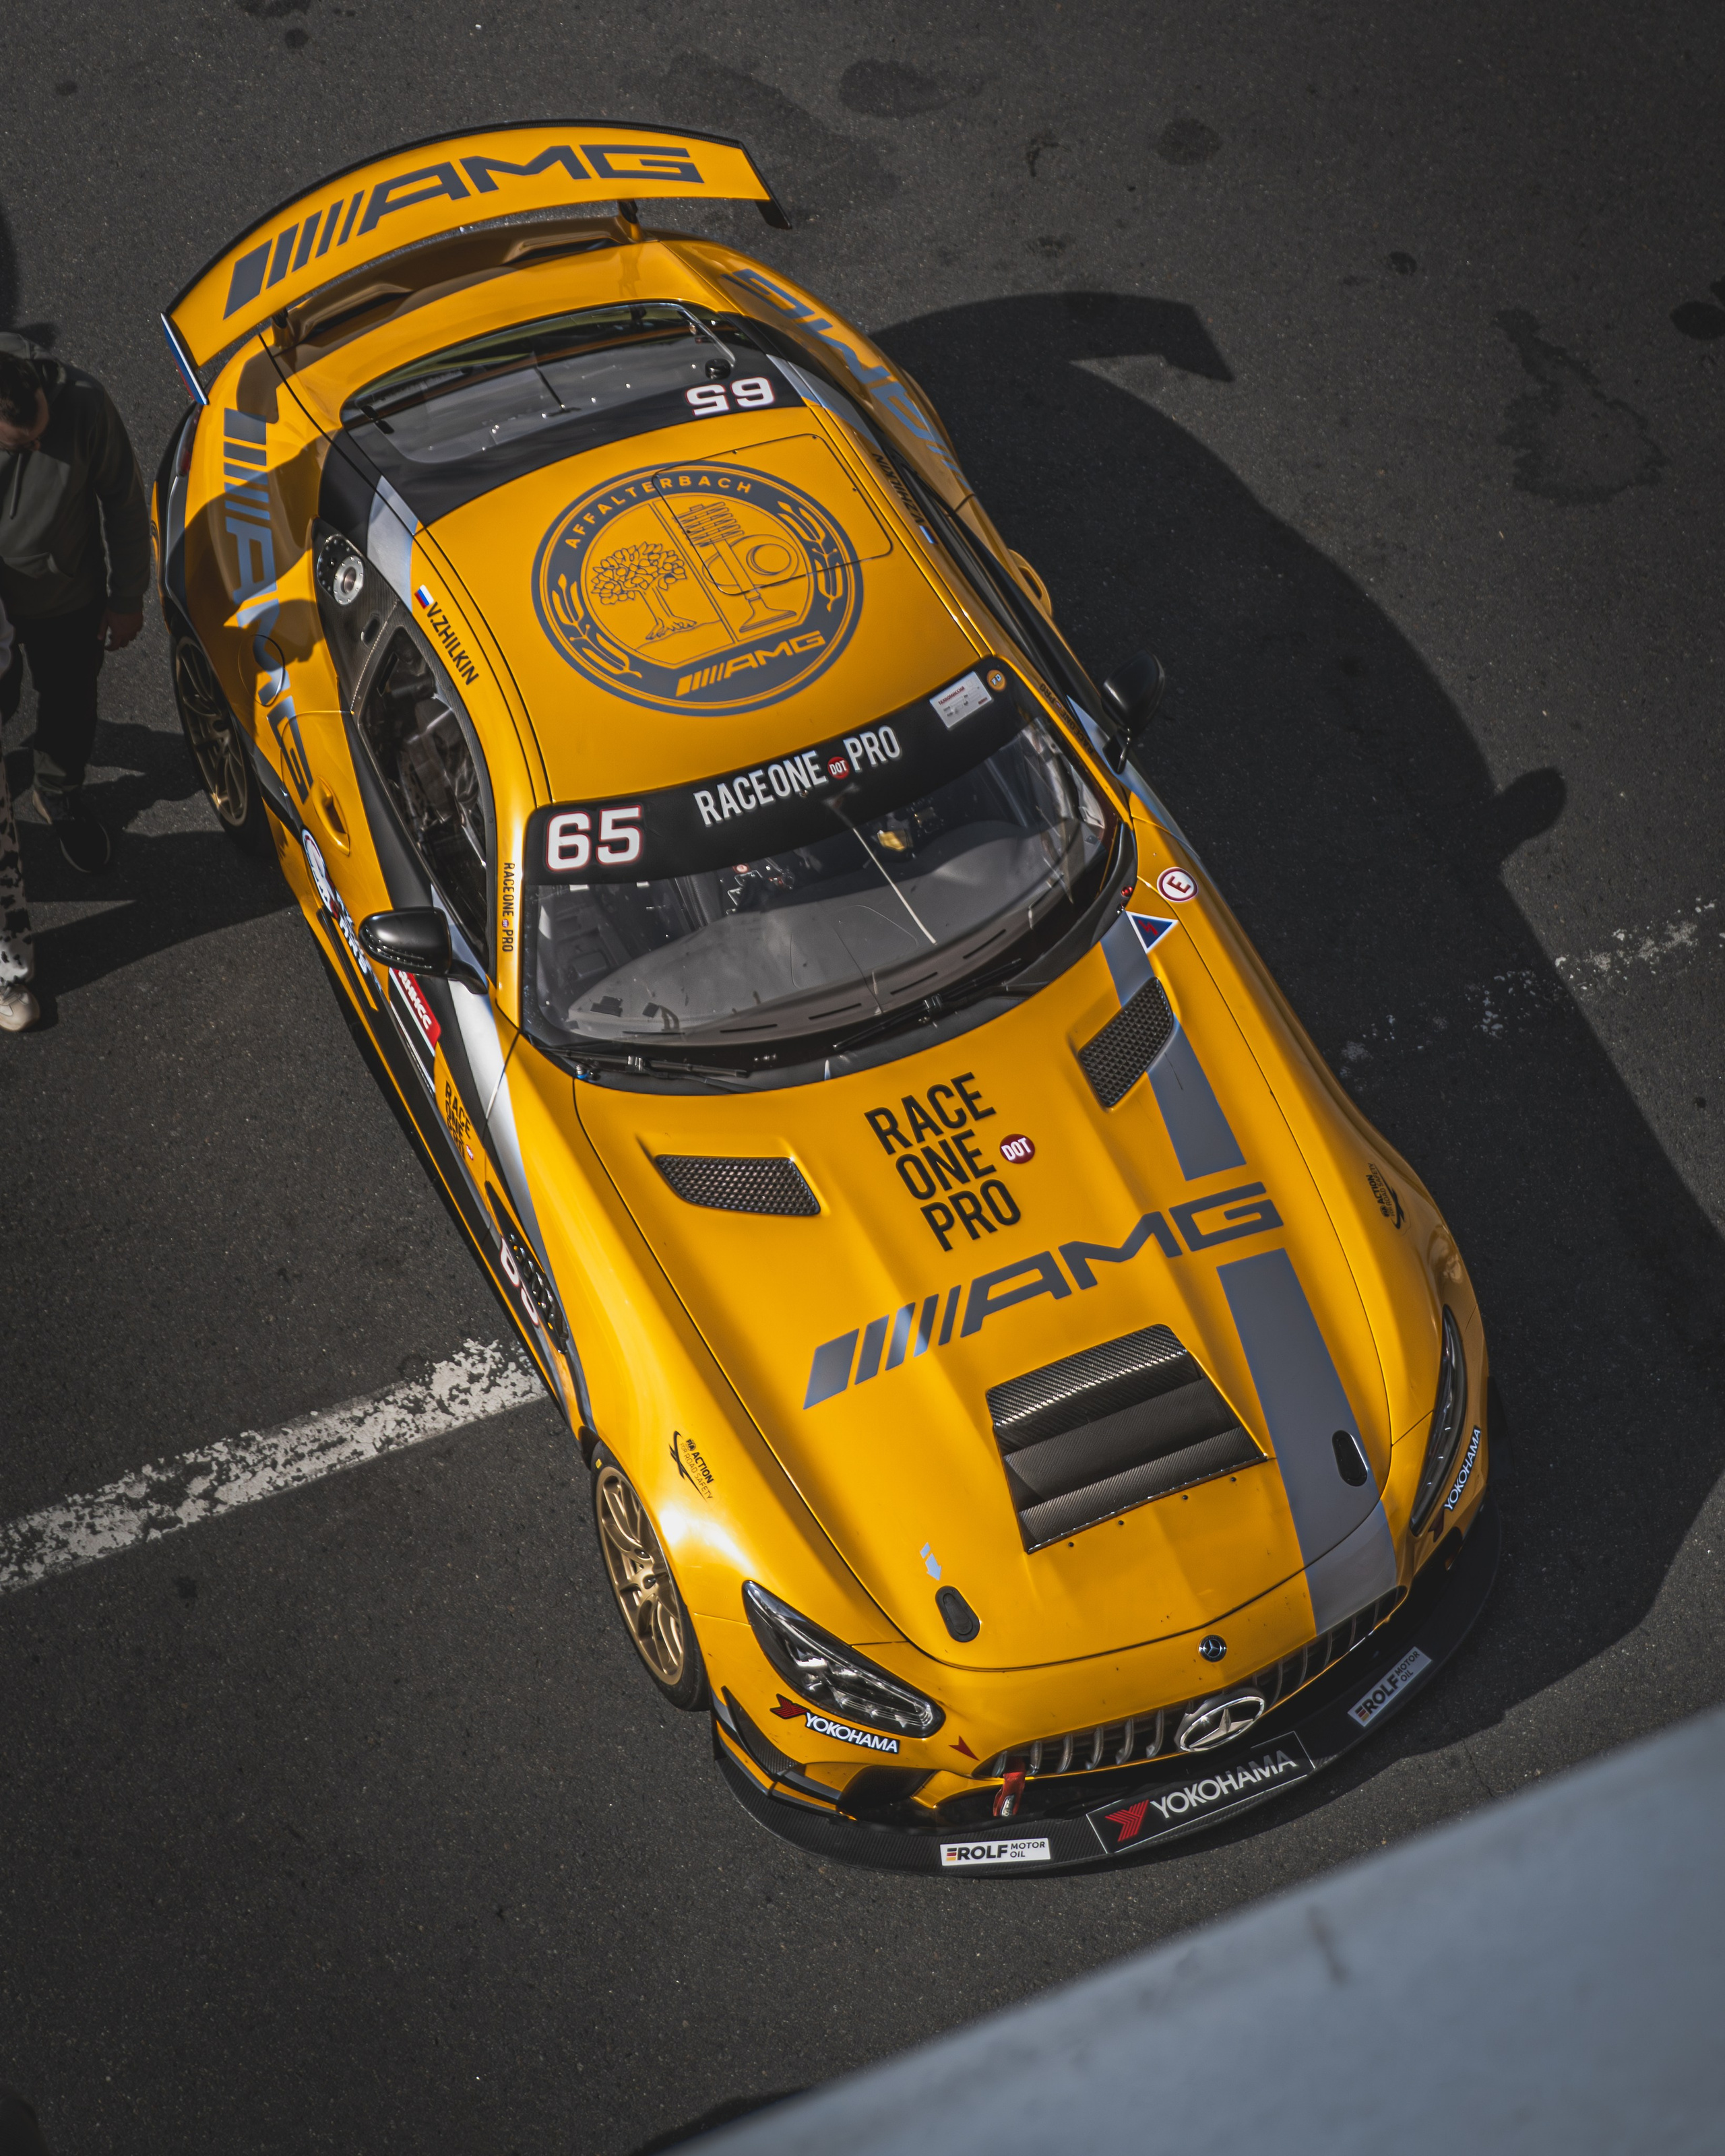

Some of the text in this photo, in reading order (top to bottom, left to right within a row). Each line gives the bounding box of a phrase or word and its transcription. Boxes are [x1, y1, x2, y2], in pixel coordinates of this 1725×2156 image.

[357, 144, 705, 236] AMG
[565, 475, 752, 549] AFFALTERBACH
[427, 602, 480, 686] V.ZHILKIN
[724, 630, 826, 679] AMG
[829, 759, 848, 775] DOT
[843, 726, 902, 773] PRO
[545, 804, 644, 873] 65
[1166, 875, 1191, 894] E
[501, 929, 514, 953] PRO
[445, 1080, 472, 1139] RACE
[864, 1071, 997, 1155] RACE
[895, 1129, 1031, 1201] ONE DOT
[1366, 1174, 1385, 1204] ACTION
[920, 1178, 1022, 1253] PRO
[960, 1180, 1284, 1338] AMG
[683, 1453, 698, 1473] ROAD
[694, 1473, 714, 1500] SAFETY
[691, 1451, 714, 1484] ACTION
[1444, 1428, 1481, 1511] YOKOHAMA
[1394, 1651, 1420, 1676] MOTOR
[1400, 1670, 1414, 1682] OIL
[1361, 1674, 1400, 1715] ROLF
[805, 1711, 899, 1754] YOKOHAMA
[1150, 1750, 1298, 1818] YOKOHAMA
[957, 1843, 1009, 1862] ROLF
[1009, 1850, 1026, 1859] OIL
[1010, 1840, 1046, 1851] MOTOR
